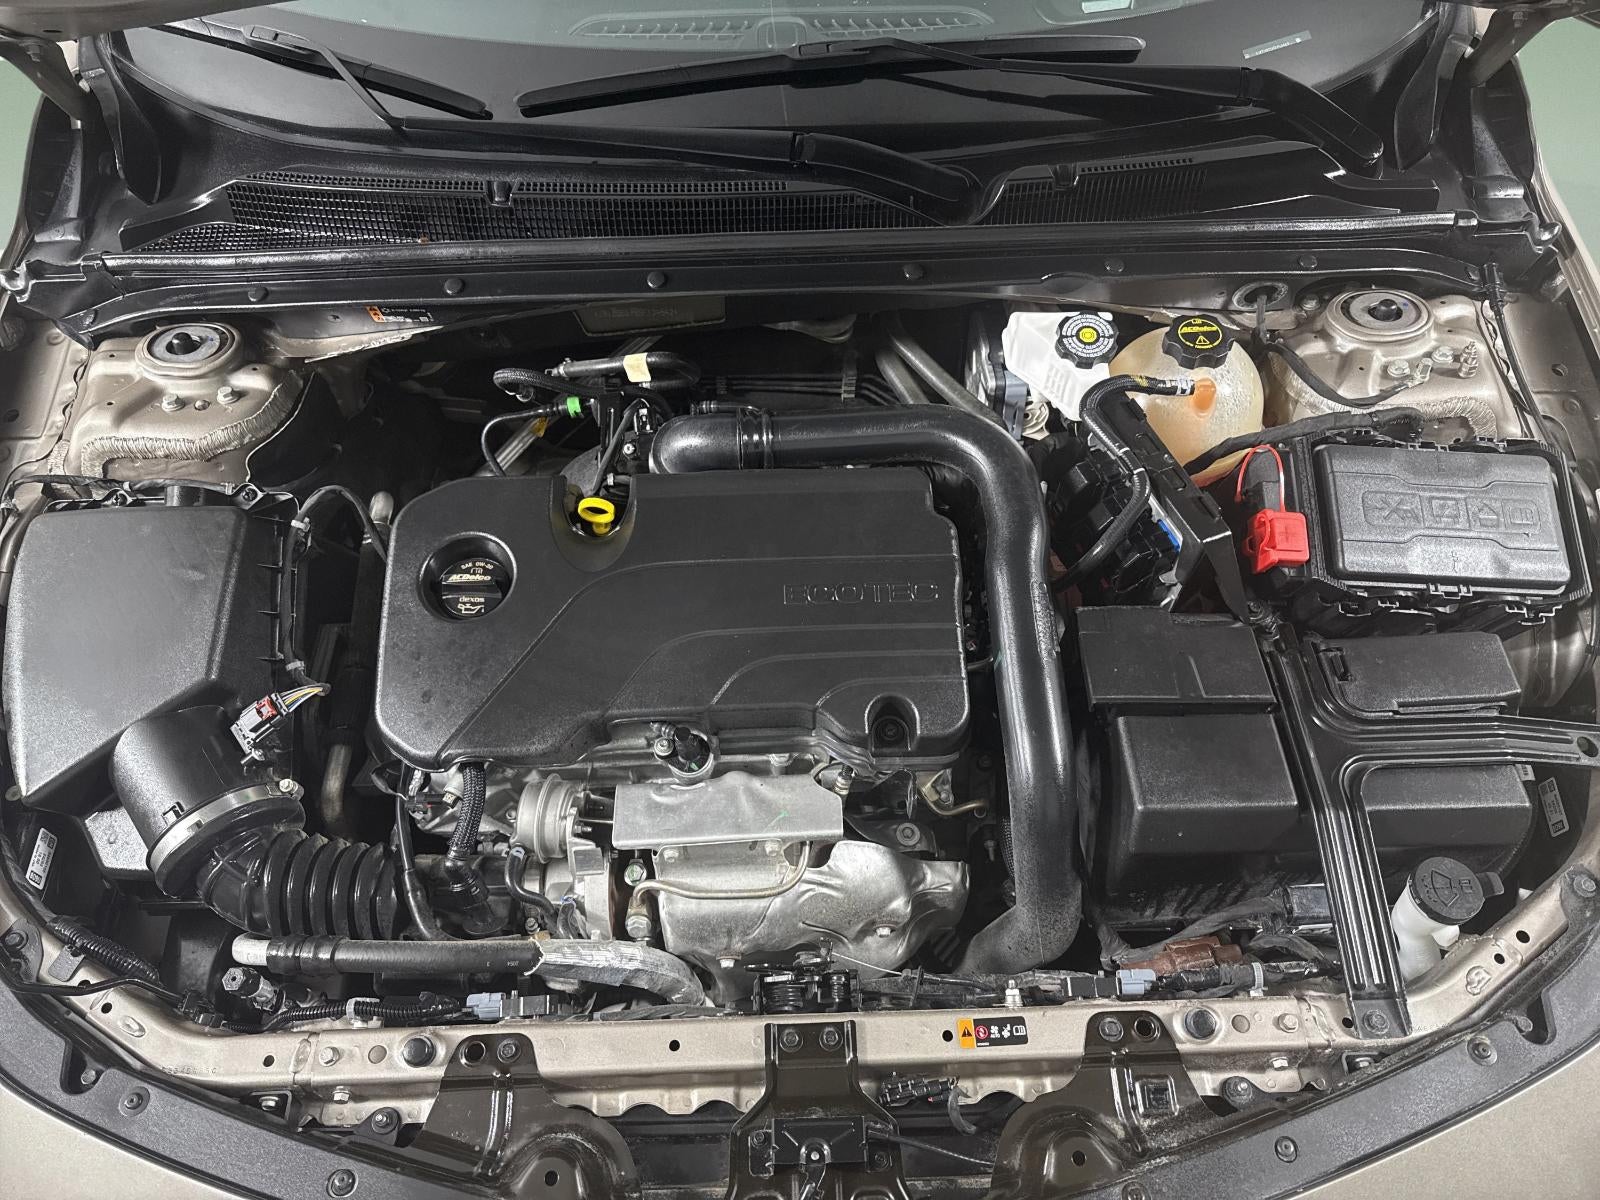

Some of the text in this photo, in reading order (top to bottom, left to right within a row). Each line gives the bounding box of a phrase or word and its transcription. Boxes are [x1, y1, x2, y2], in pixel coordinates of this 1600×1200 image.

[460, 562, 473, 570] SAE
[446, 573, 492, 583] ACDelco
[783, 582, 939, 605] ECOTEC
[459, 595, 485, 603] dexos
